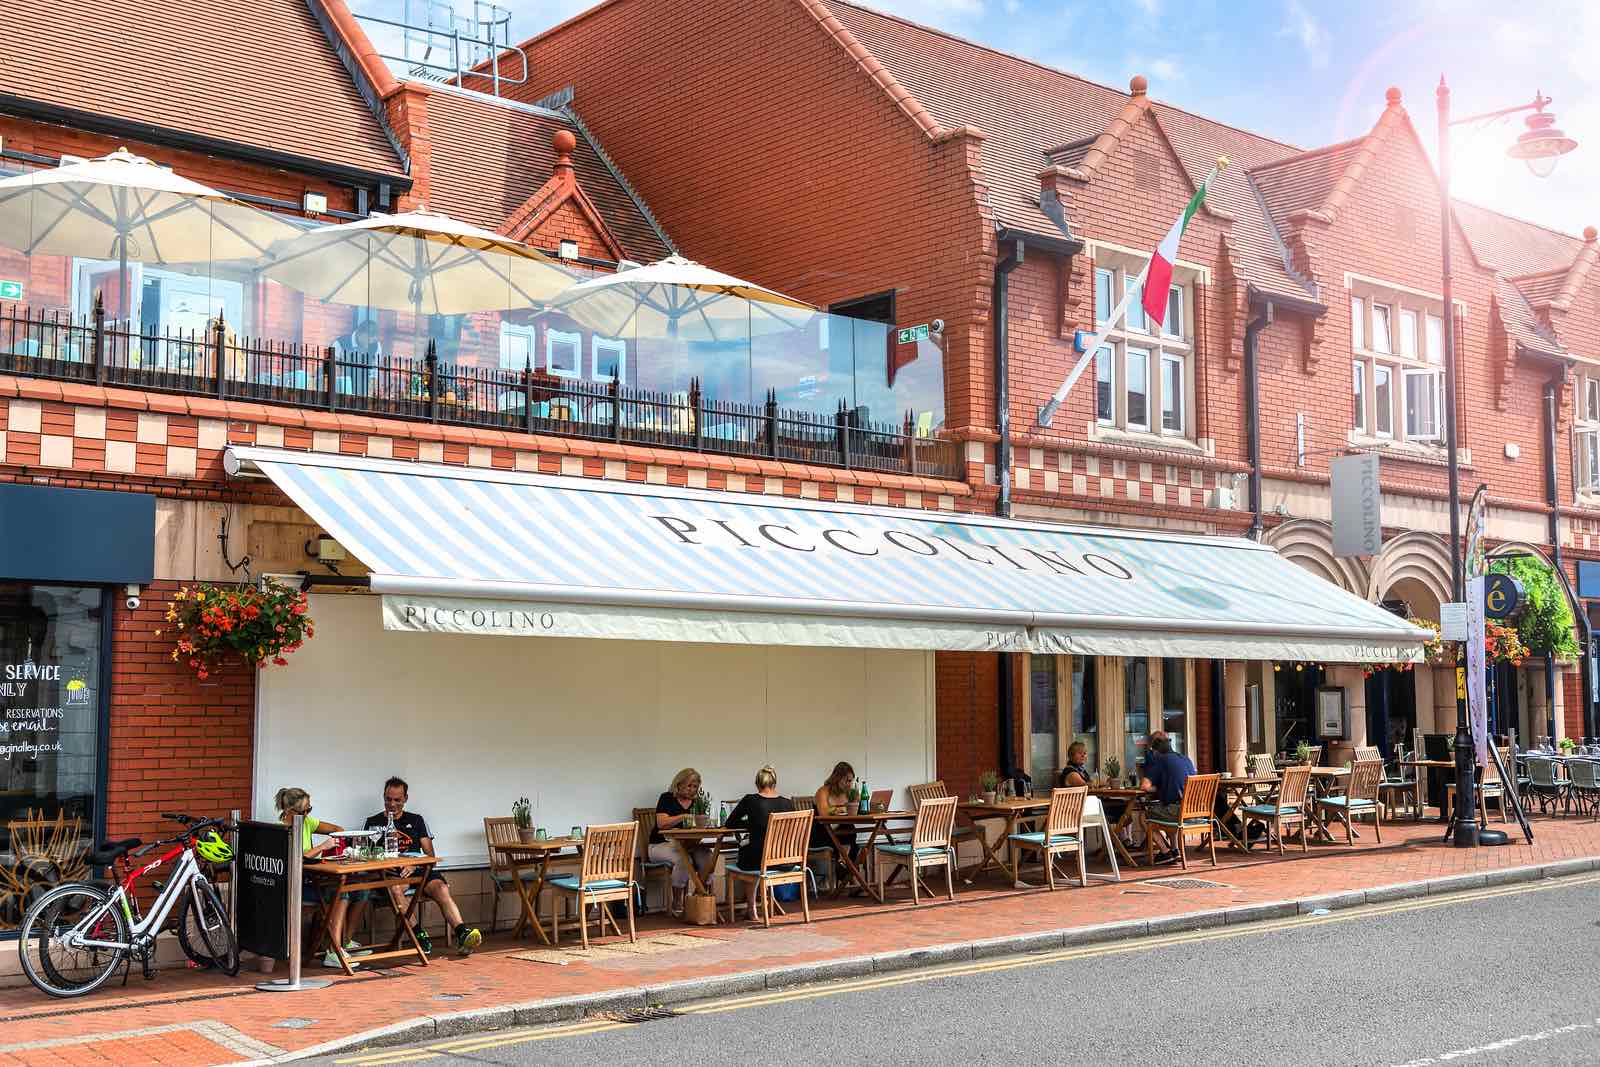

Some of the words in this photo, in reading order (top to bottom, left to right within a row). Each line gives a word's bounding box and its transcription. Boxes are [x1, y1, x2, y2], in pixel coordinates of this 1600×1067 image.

[1361, 459, 1375, 551] PICCOLINO
[648, 515, 1133, 580] PICCOLINO
[1487, 580, 1505, 611] é
[404, 606, 554, 629] PICCOLINO
[7, 708, 64, 718] RESERVATIONS
[244, 854, 284, 875] PICCOLINO
